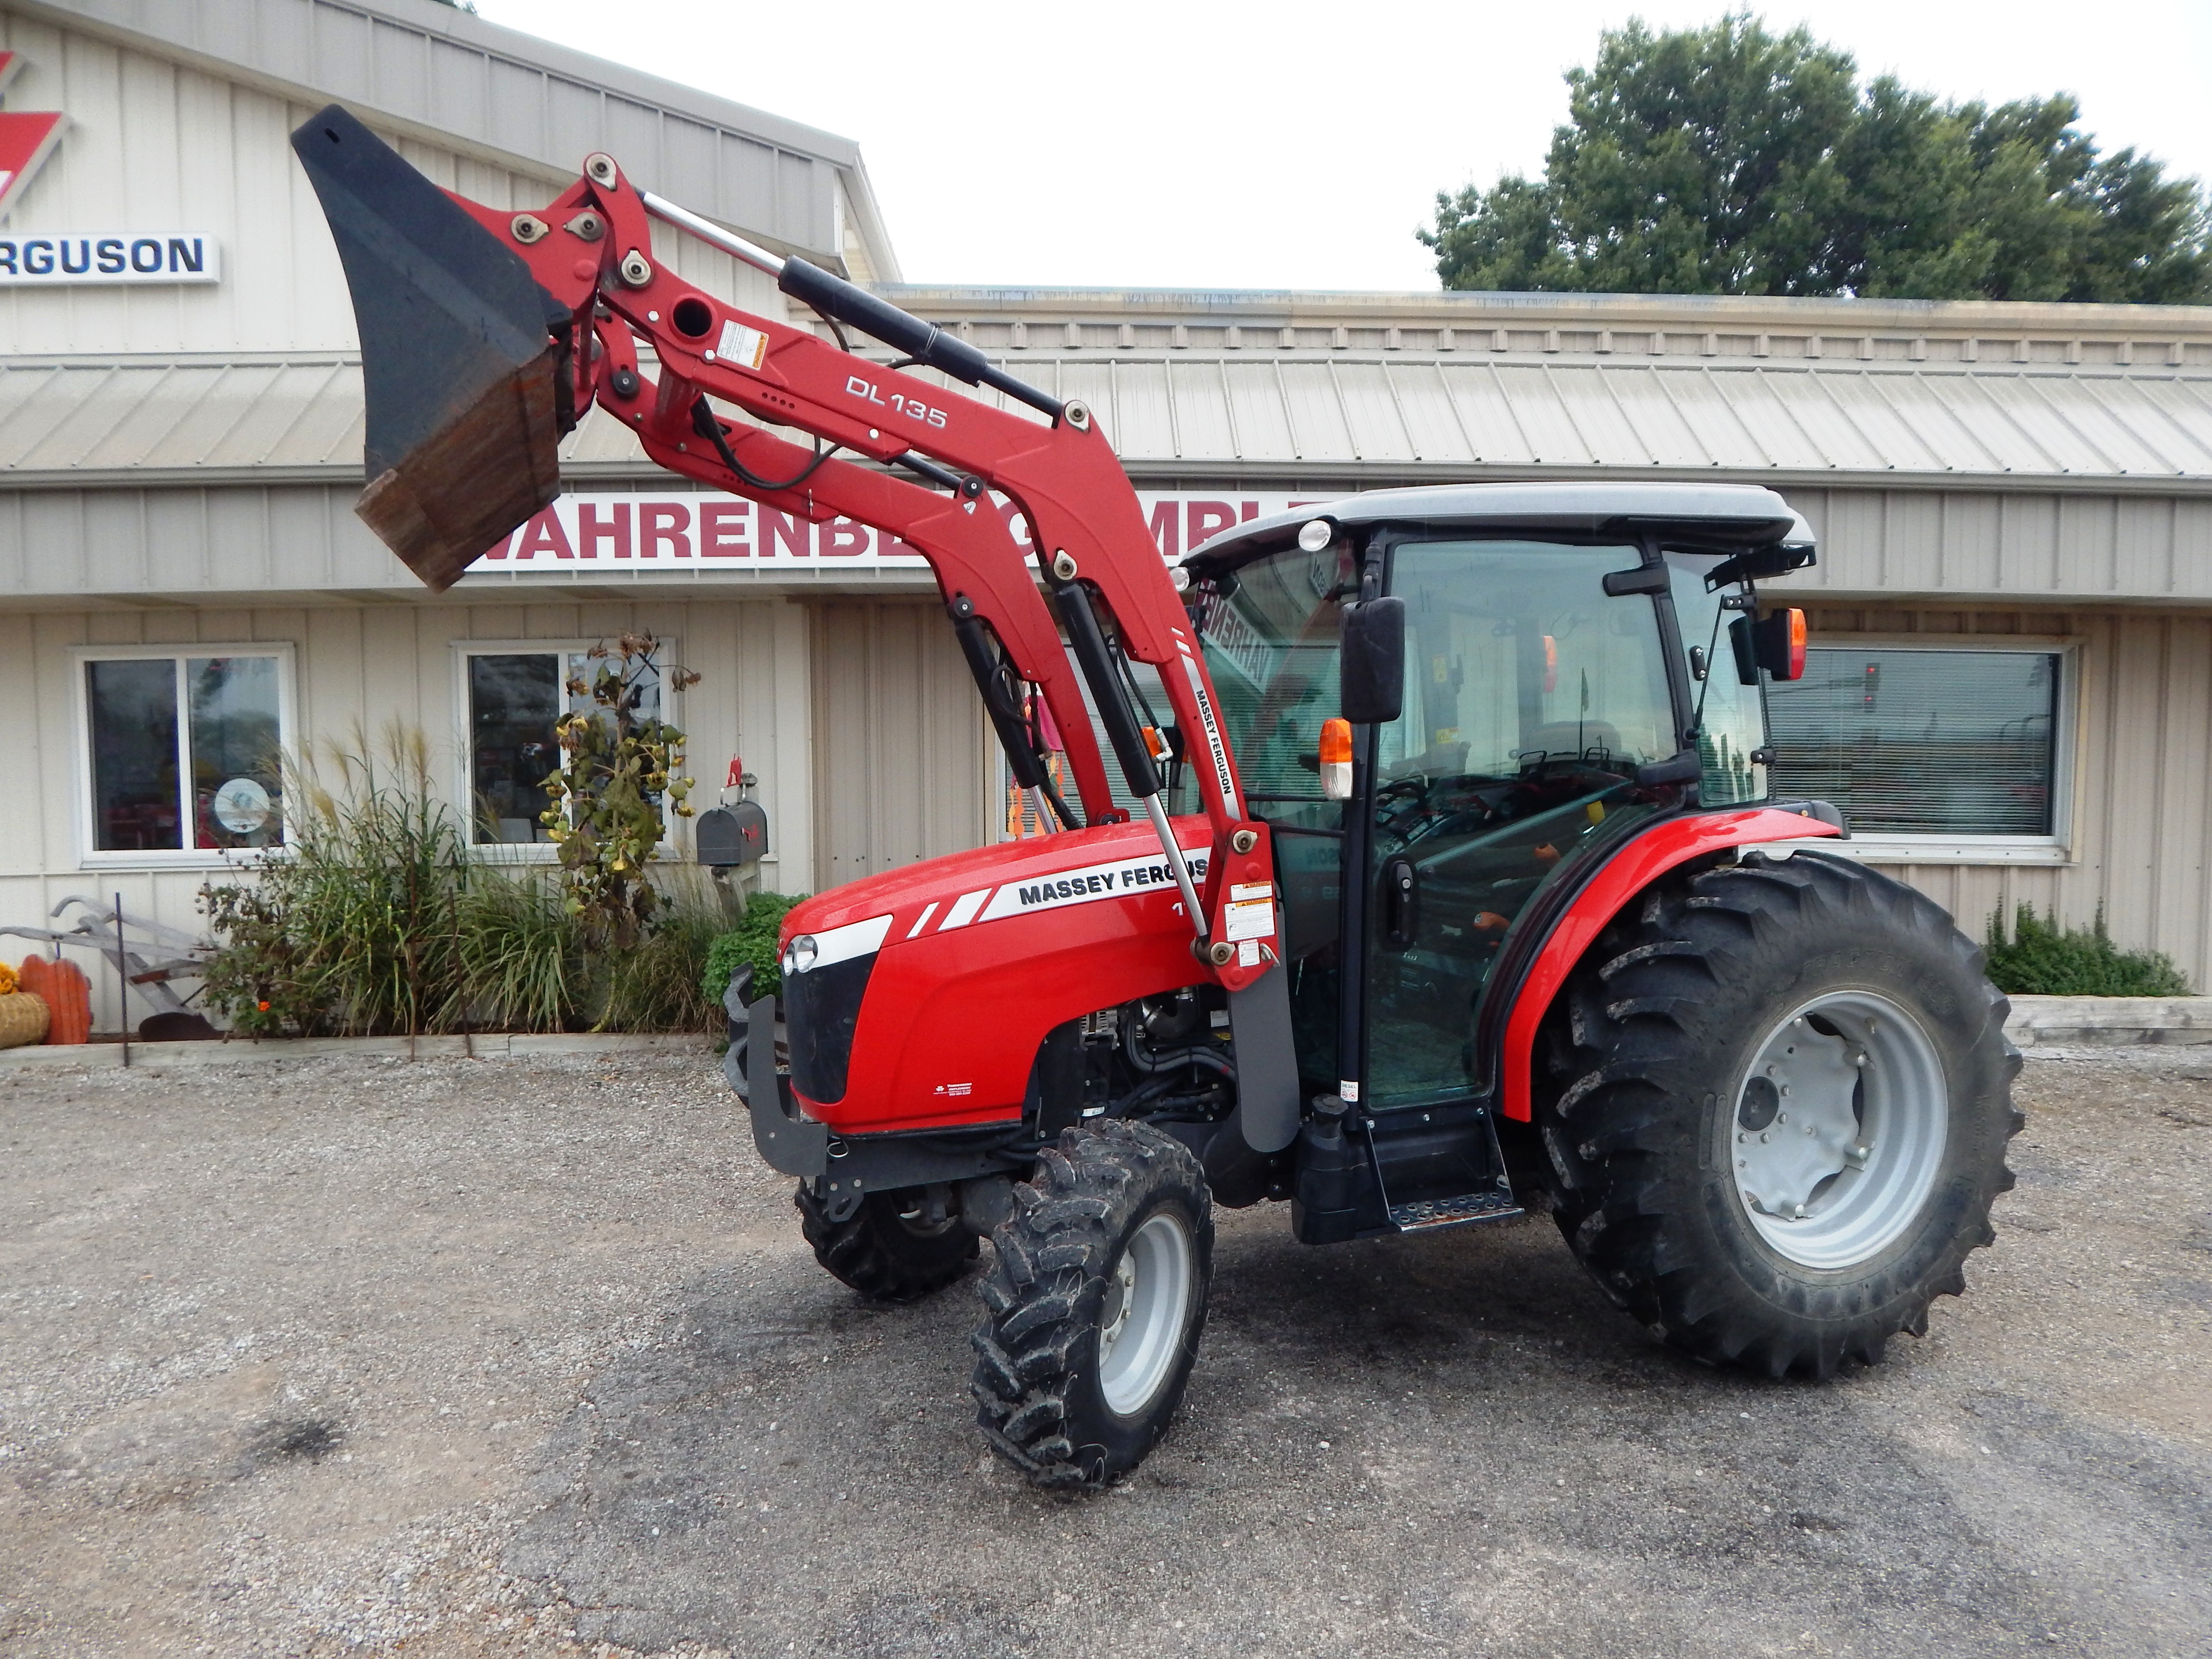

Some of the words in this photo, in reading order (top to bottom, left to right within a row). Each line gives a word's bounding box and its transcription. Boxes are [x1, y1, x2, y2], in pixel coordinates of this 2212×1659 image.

[1196, 689, 1216, 733] MASSEY
[1211, 737, 1231, 794] FERGUSON
[1019, 873, 1115, 905] MASSEY
